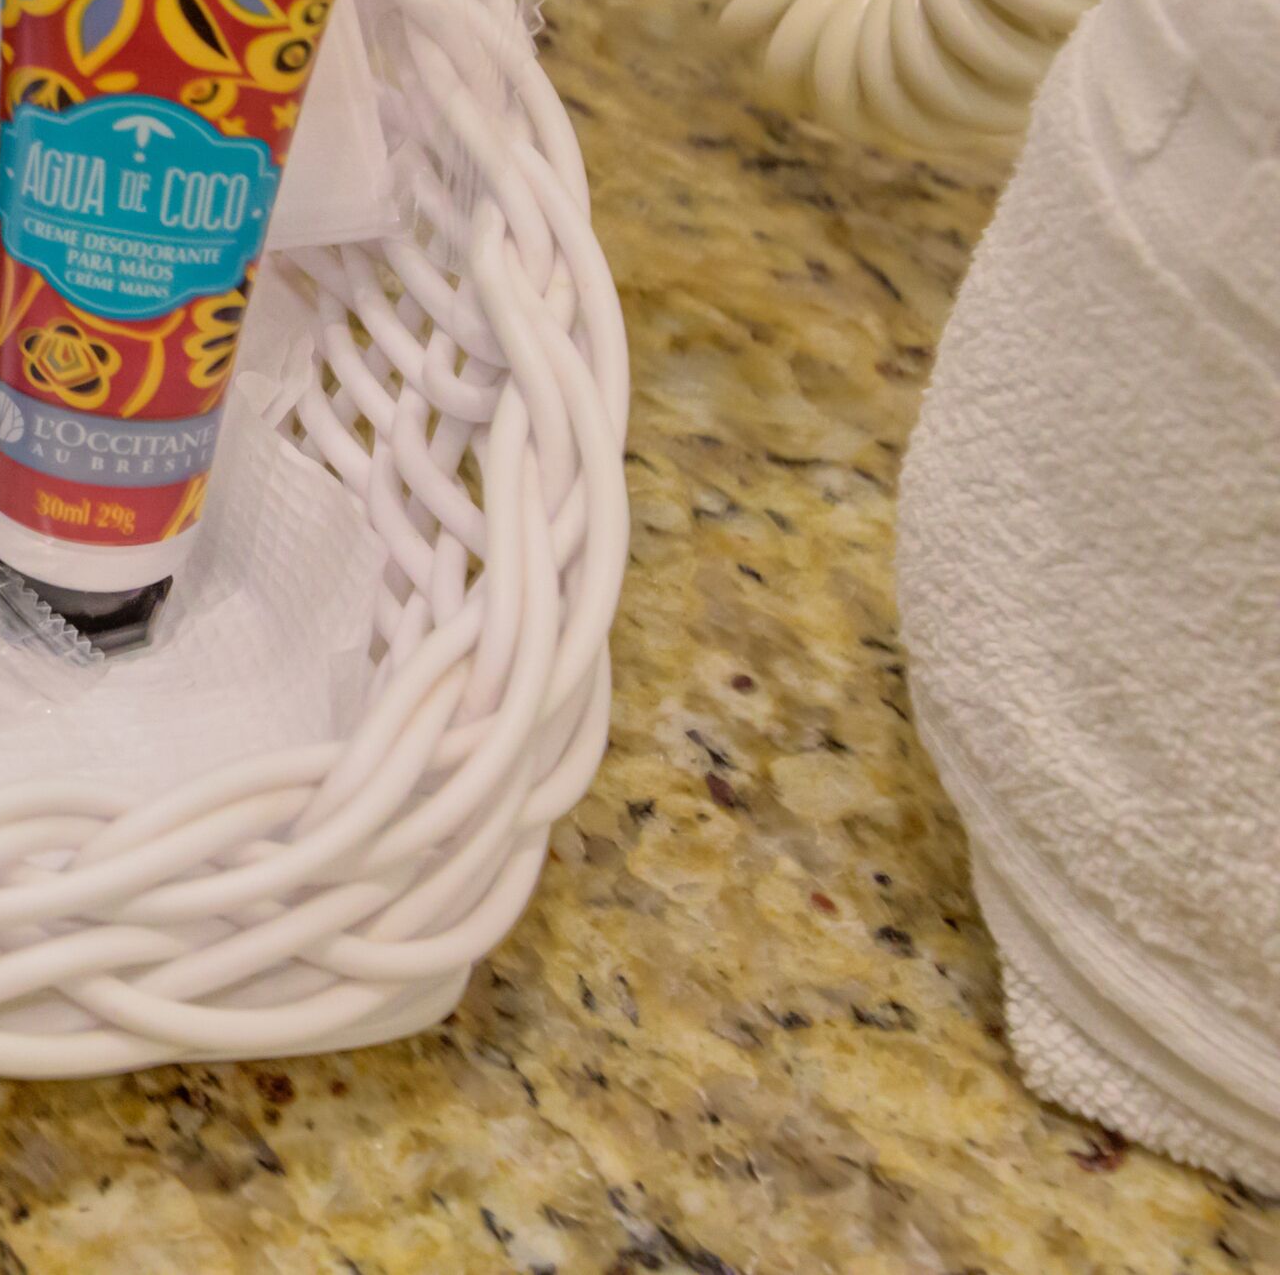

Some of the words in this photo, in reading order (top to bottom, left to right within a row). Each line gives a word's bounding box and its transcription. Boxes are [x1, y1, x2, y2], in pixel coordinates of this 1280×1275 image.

[118, 170, 152, 213] DE
[159, 167, 250, 232] COCO
[24, 216, 79, 247] CREME
[83, 233, 222, 266] DESODORANTE
[67, 248, 115, 274] PARA
[118, 281, 171, 299] MAINS
[32, 444, 72, 464] AU
[36, 488, 91, 525] 30ml
[96, 502, 137, 536] 29g
